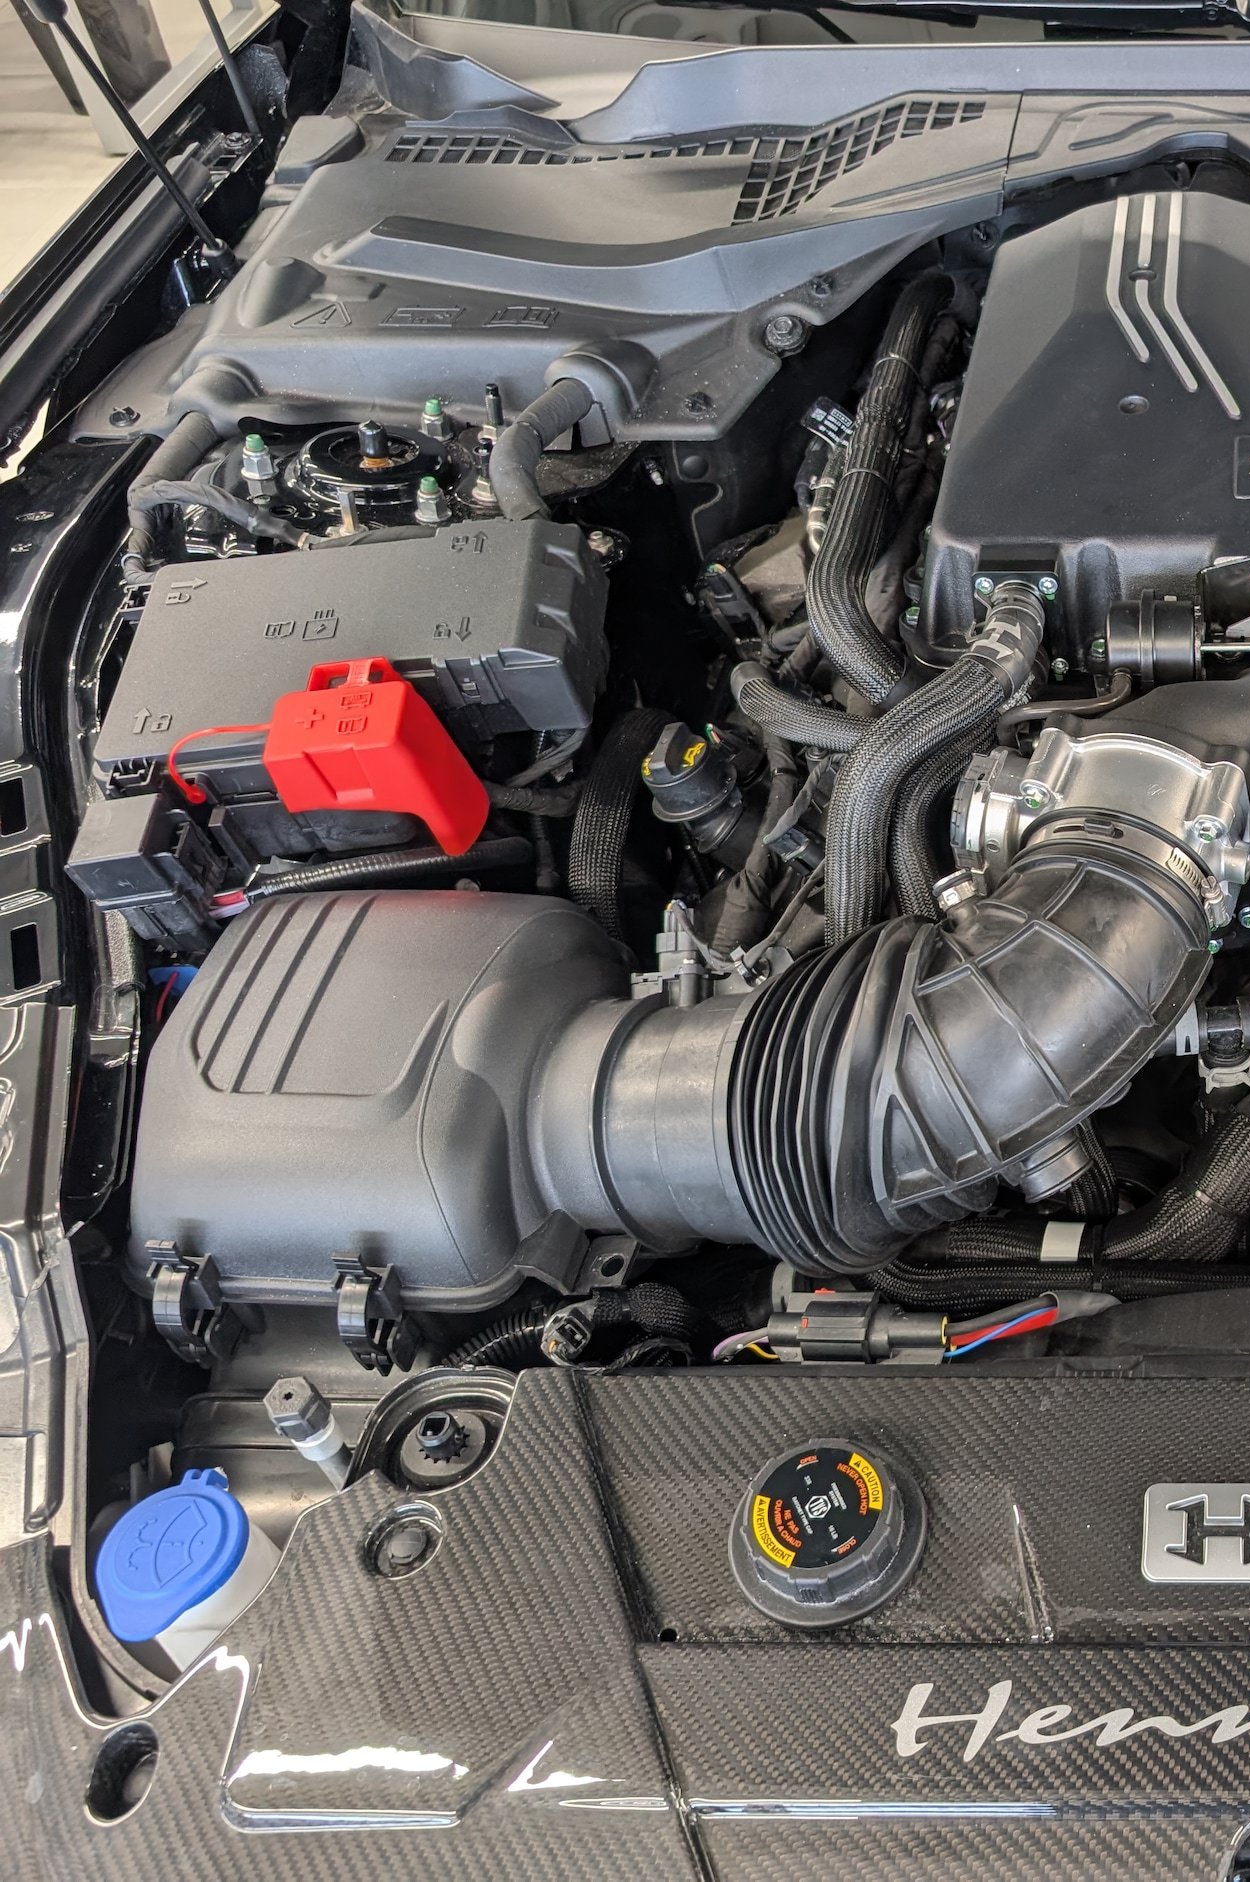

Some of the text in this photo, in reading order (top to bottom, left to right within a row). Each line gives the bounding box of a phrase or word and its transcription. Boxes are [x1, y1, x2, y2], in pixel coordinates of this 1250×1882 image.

[799, 1455, 818, 1465] OPEN
[836, 1463, 868, 1516] NEVER OPEN HOT
[861, 1465, 880, 1503] CAUTION
[774, 1499, 783, 1527] OUVRIR
[780, 1529, 802, 1549] CHAUD
[783, 1509, 800, 1534] NE PAS
[809, 1498, 828, 1516] TVS
[757, 1507, 792, 1562] AVERTISSEMENT
